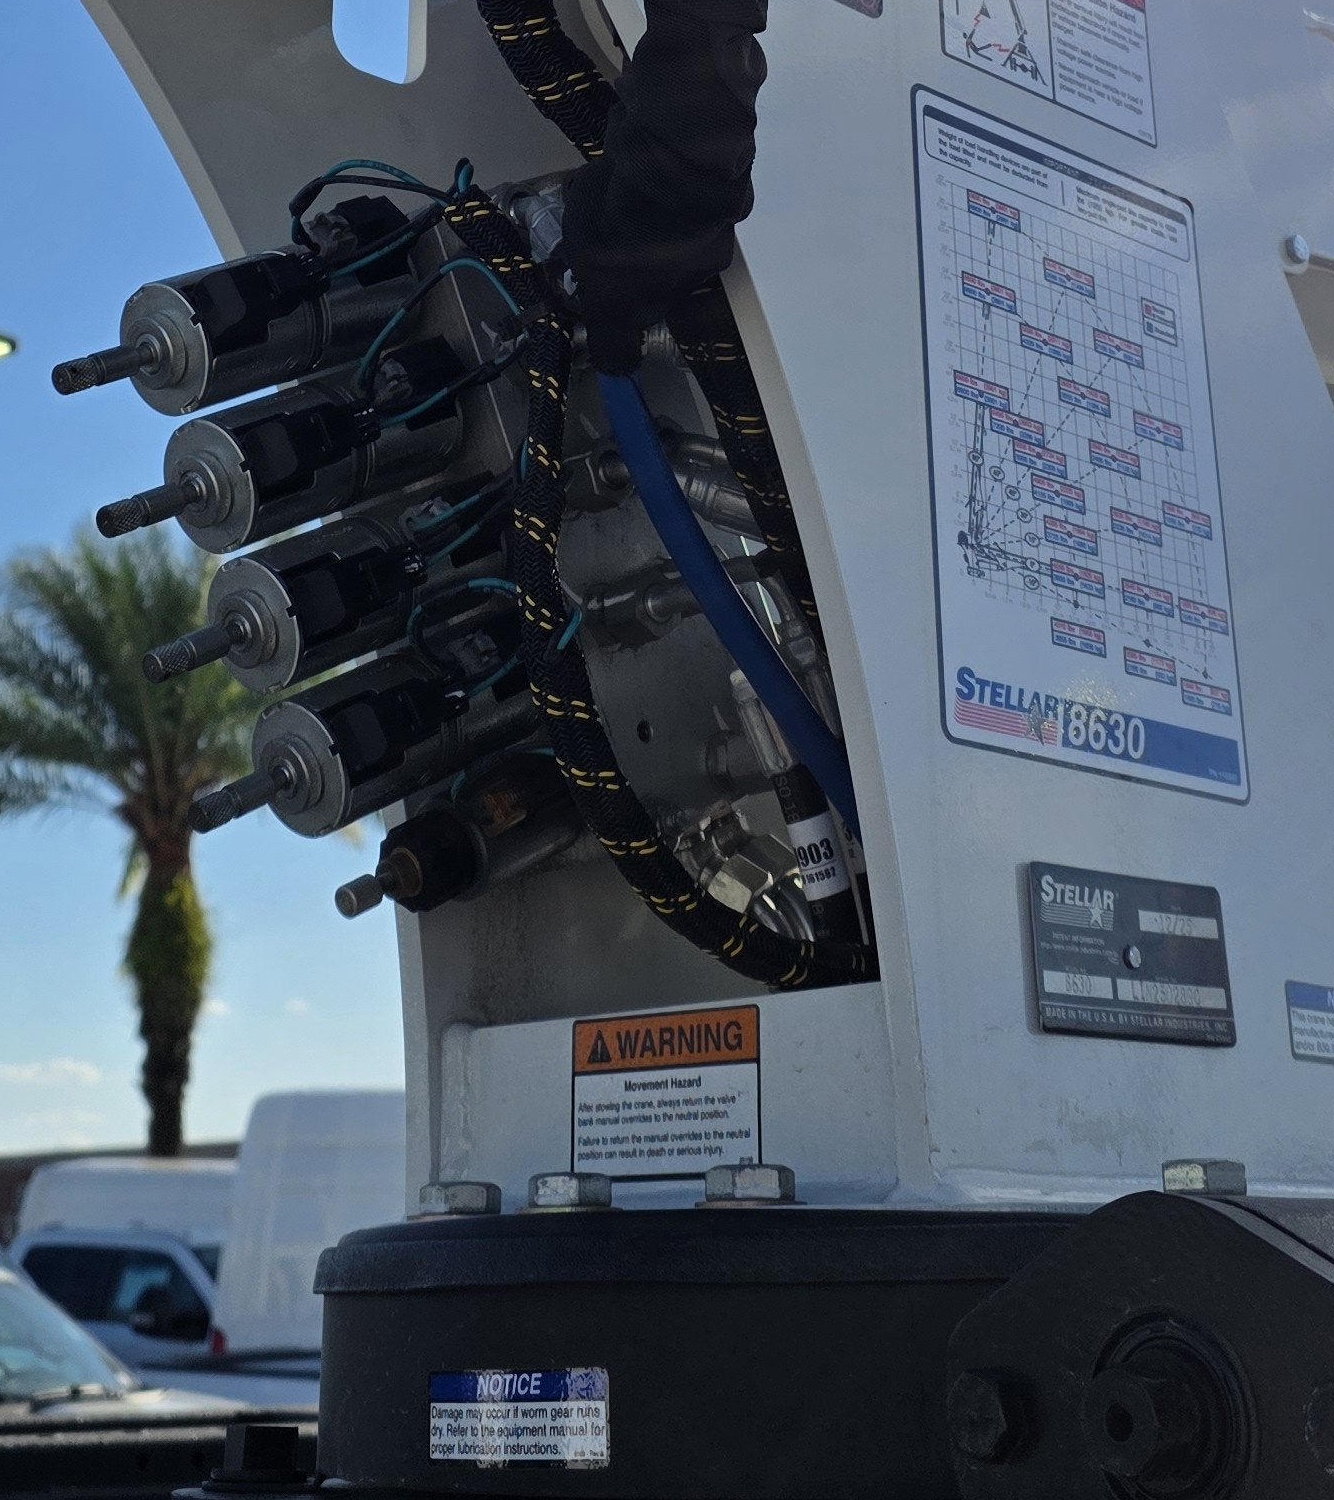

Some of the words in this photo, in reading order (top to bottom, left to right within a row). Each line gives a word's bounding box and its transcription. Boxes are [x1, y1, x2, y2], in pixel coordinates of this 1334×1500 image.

[1109, 3, 1136, 23] Hazard
[955, 665, 1064, 724] STELLAR
[1067, 703, 1145, 760] 8630
[1041, 875, 1113, 909] STELLAR
[1045, 1007, 1065, 1018] MADE
[1067, 1009, 1075, 1019] IN
[1077, 1009, 1091, 1021] THE
[1118, 1013, 1127, 1024] BY
[1130, 1014, 1162, 1026] STELLAR
[617, 1020, 743, 1059] WARNING
[624, 1078, 668, 1092] Movement
[670, 1074, 702, 1089] Hazard
[578, 1102, 593, 1113] After
[595, 1102, 620, 1113] stowing
[622, 1100, 632, 1110] the
[634, 1100, 656, 1110] crane,
[657, 1098, 680, 1110] always
[682, 1097, 702, 1106] return
[704, 1096, 716, 1105] the
[717, 1094, 736, 1104] valve
[578, 1116, 593, 1127] bank
[595, 1115, 620, 1125] manual
[621, 1113, 653, 1124] overrides
[654, 1113, 661, 1122] to
[662, 1112, 673, 1122] the
[675, 1110, 699, 1120] neutral
[700, 1109, 730, 1120] position.
[578, 1135, 600, 1146] Failure
[602, 1135, 608, 1145] to
[610, 1135, 630, 1145] return
[631, 1133, 642, 1143] the
[643, 1132, 669, 1142] manual
[670, 1130, 702, 1142] overrides
[704, 1130, 711, 1140] to
[713, 1129, 724, 1139] the
[726, 1127, 750, 1138] neutral
[578, 1150, 603, 1162] position
[605, 1151, 617, 1159] can
[619, 1149, 637, 1158] result
[639, 1148, 645, 1157] in
[646, 1146, 666, 1157] death
[667, 1147, 675, 1156] or
[676, 1145, 702, 1155] serious
[704, 1144, 724, 1158] injury.
[477, 1373, 543, 1396] NOTICE
[431, 1406, 464, 1421] Damage
[466, 1407, 483, 1421] may
[485, 1408, 510, 1419] occur
[521, 1407, 548, 1418] worm
[550, 1407, 573, 1421] gear
[576, 1406, 600, 1418] runs
[431, 1424, 443, 1439] dry.
[446, 1424, 468, 1437] Refer
[470, 1424, 478, 1437] to
[481, 1424, 495, 1437] the
[497, 1424, 547, 1440] equipment
[549, 1422, 588, 1436] manual
[591, 1422, 605, 1436] for
[431, 1444, 456, 1457] proper
[457, 1442, 502, 1455] lubrication
[503, 1442, 561, 1455] instructions.
